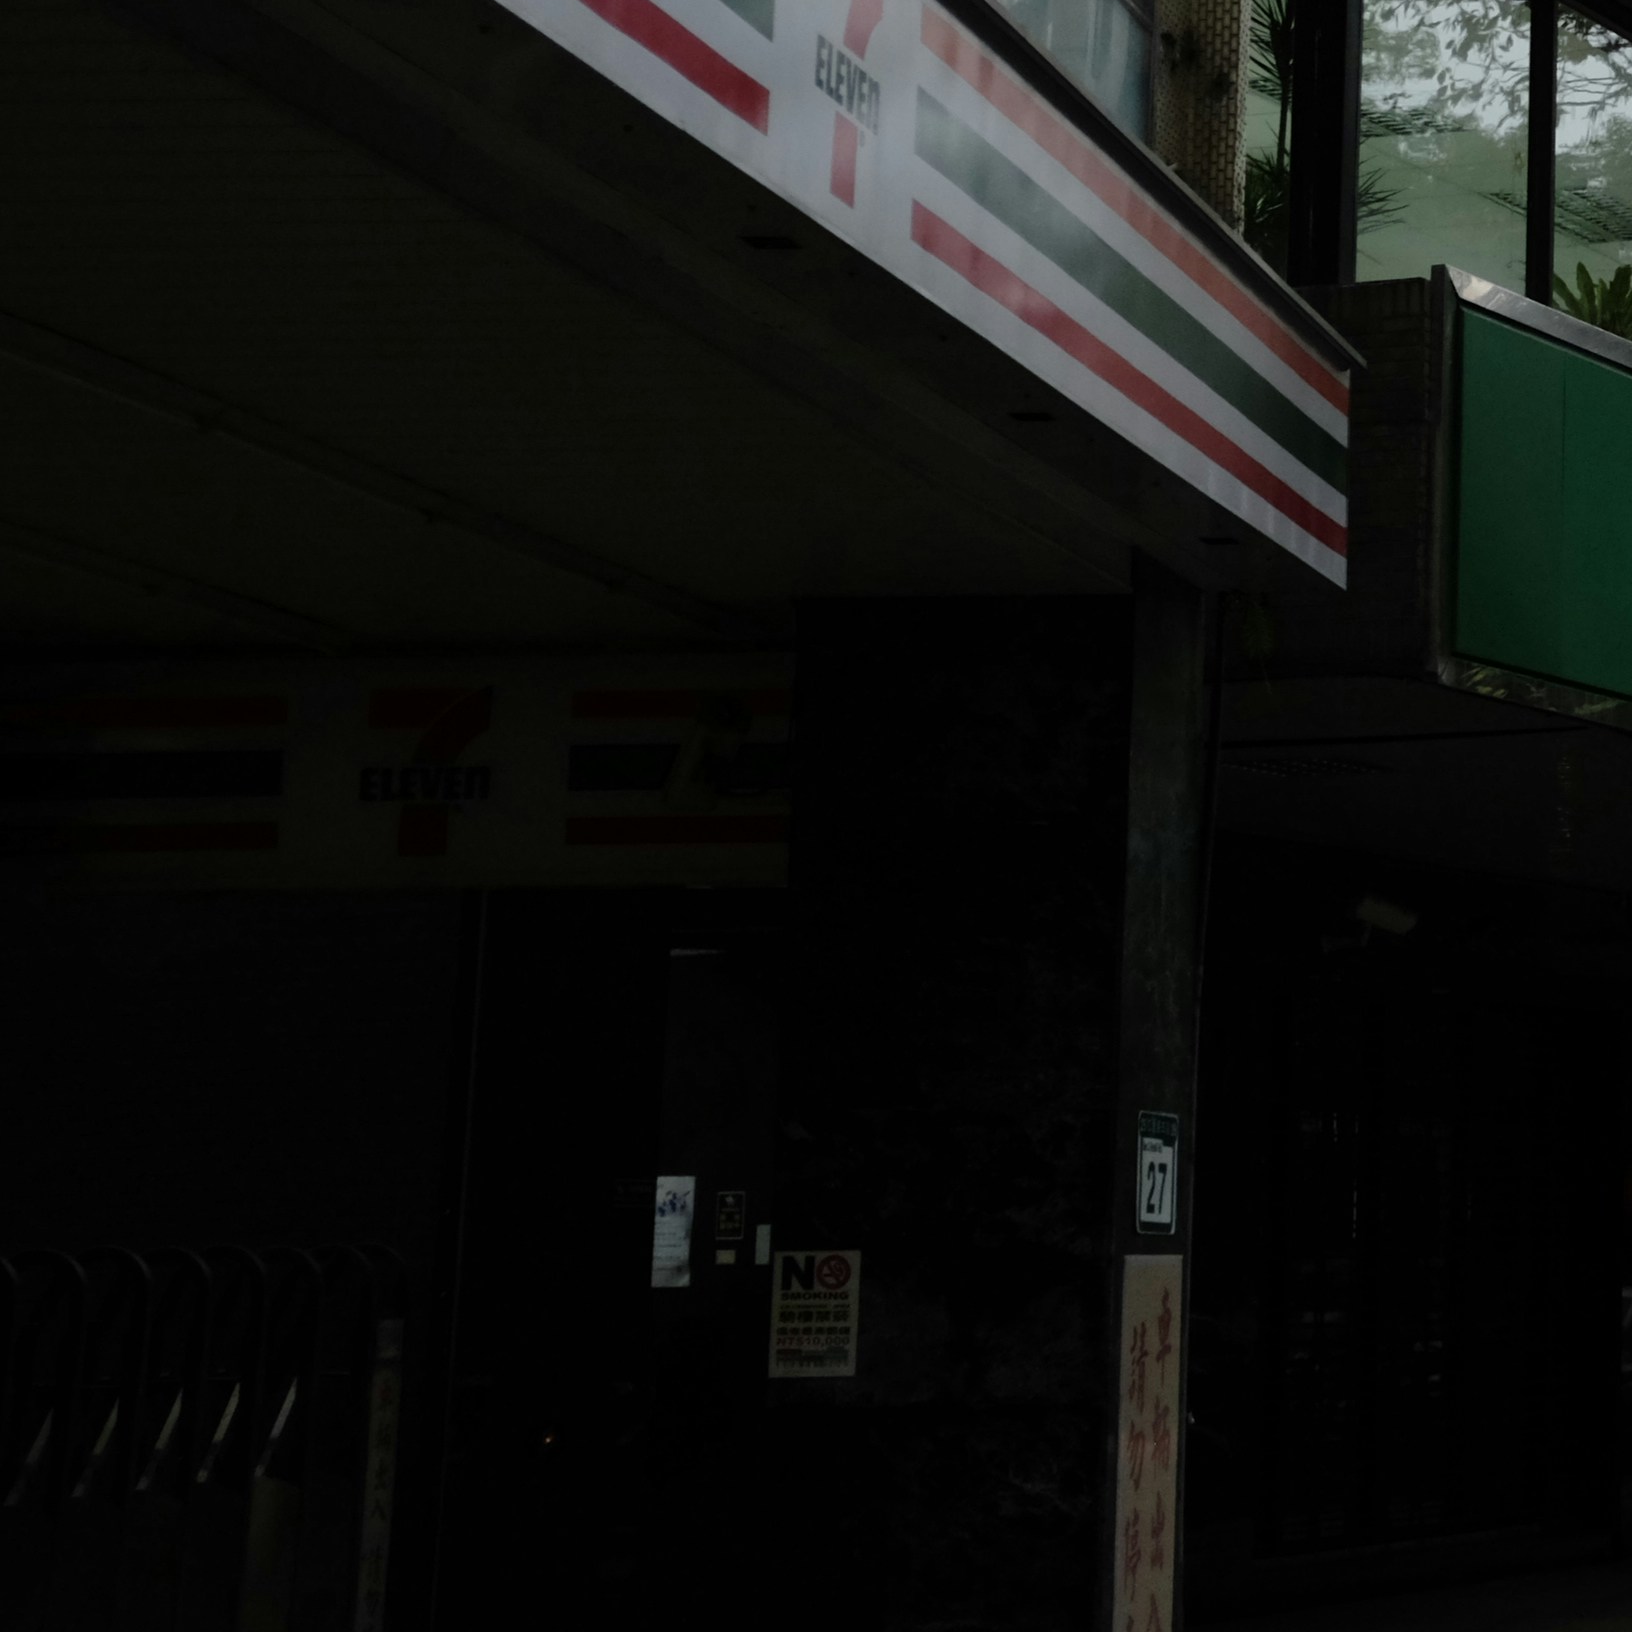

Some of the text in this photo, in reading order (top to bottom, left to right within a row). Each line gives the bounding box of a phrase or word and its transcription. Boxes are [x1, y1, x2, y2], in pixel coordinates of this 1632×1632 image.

[1146, 1160, 1168, 1216] 27
[780, 1291, 850, 1301] SMOKING
[1123, 1321, 1149, 1632] 請勿停
